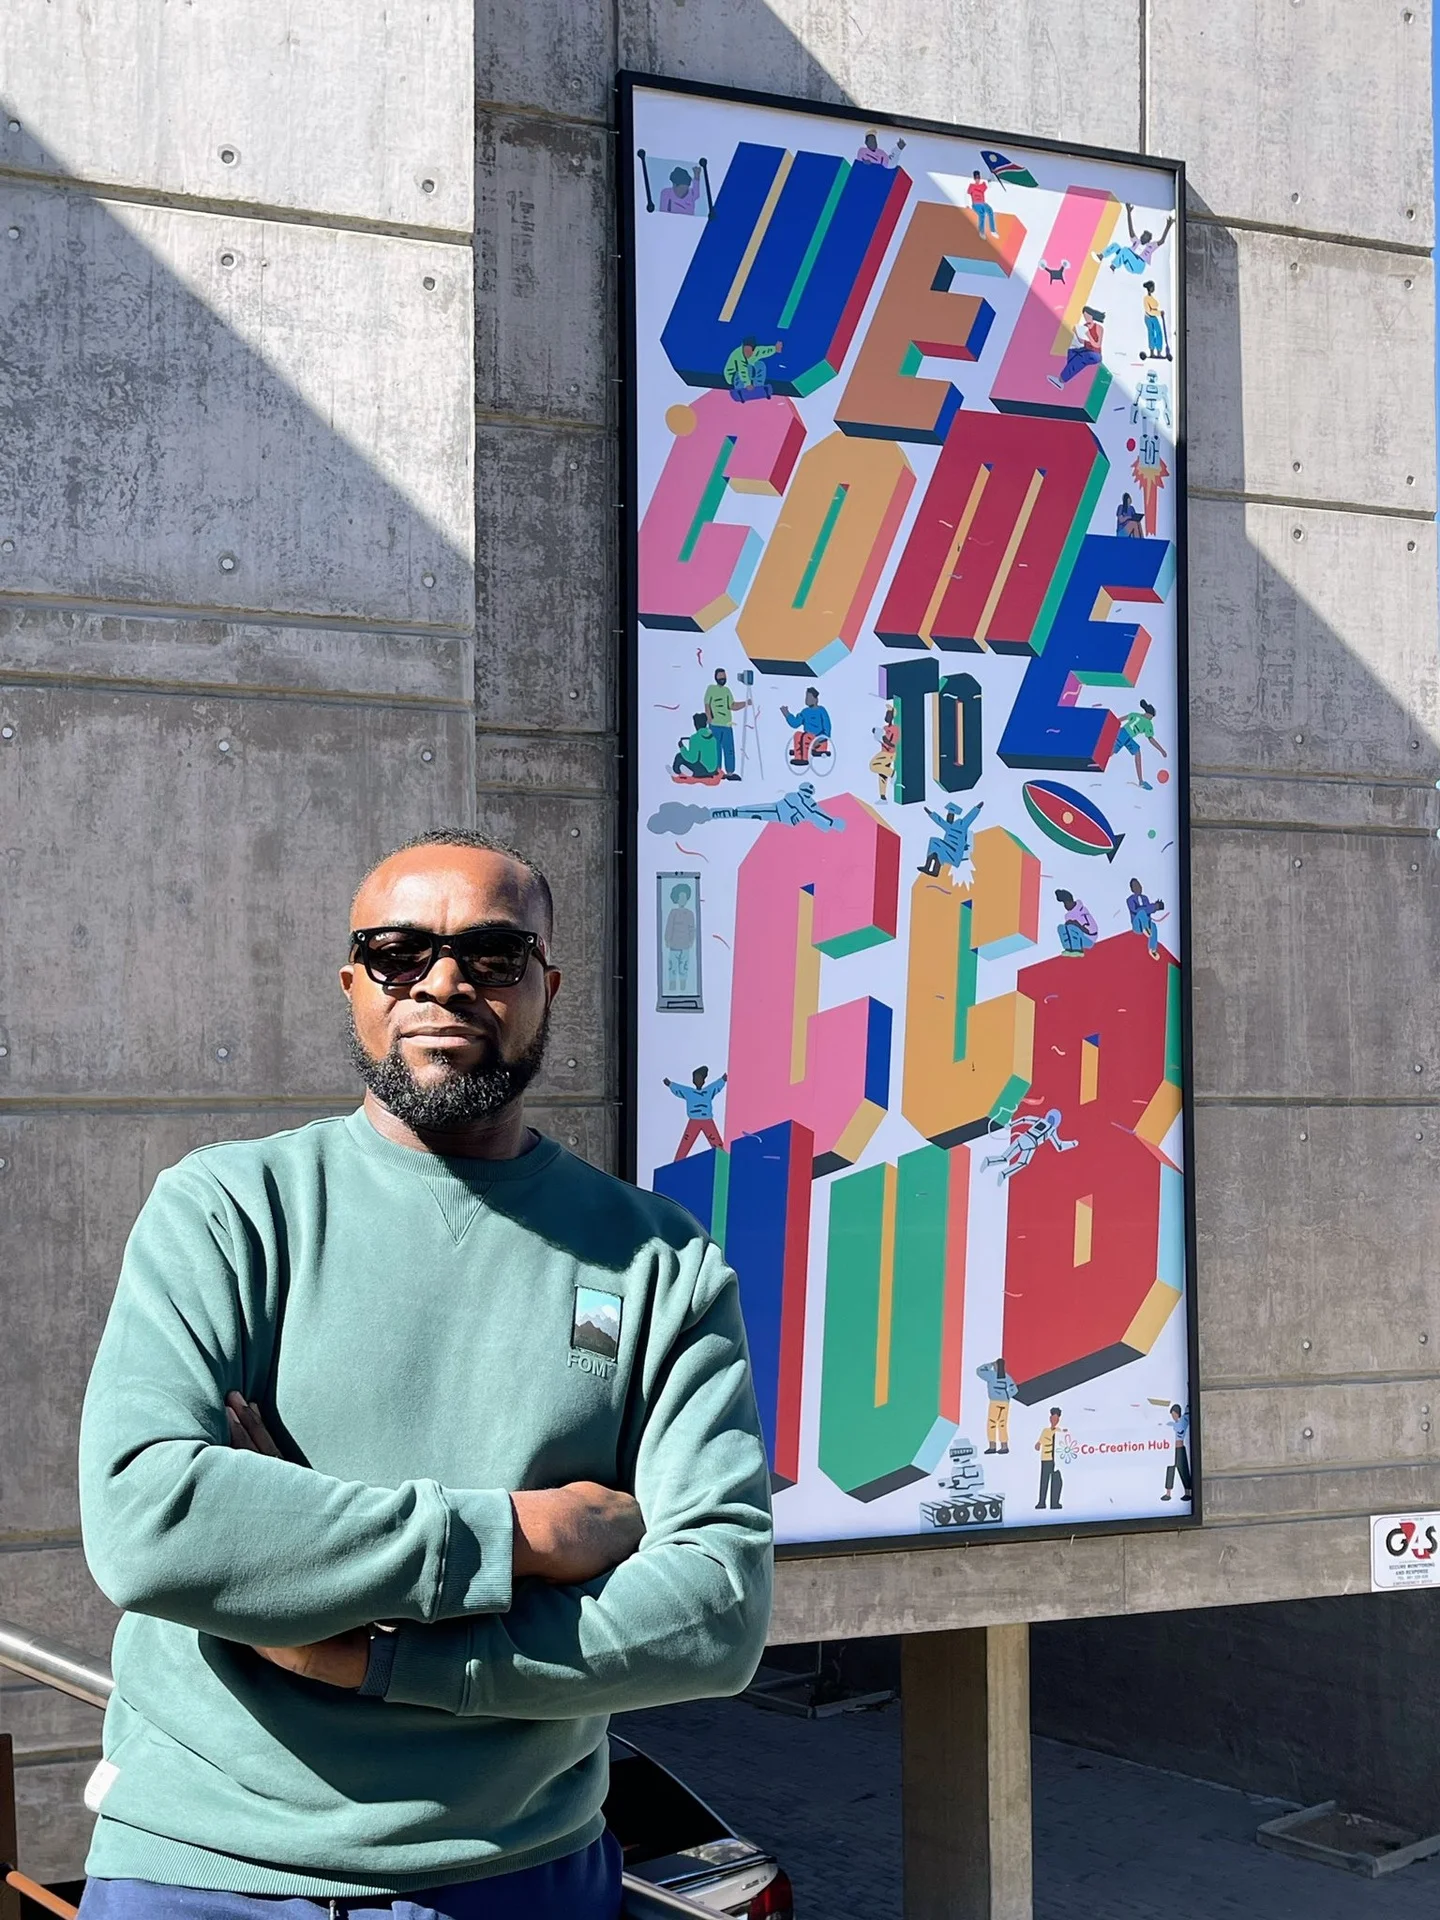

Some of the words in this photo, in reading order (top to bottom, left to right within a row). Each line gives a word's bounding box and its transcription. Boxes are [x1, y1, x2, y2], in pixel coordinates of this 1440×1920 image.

[660, 140, 1122, 446] WEL
[879, 656, 984, 806] TO
[1081, 1440, 1145, 1455] Co-Creation
[1148, 1439, 1170, 1451] Hub
[1385, 1521, 1438, 1560] G4S
